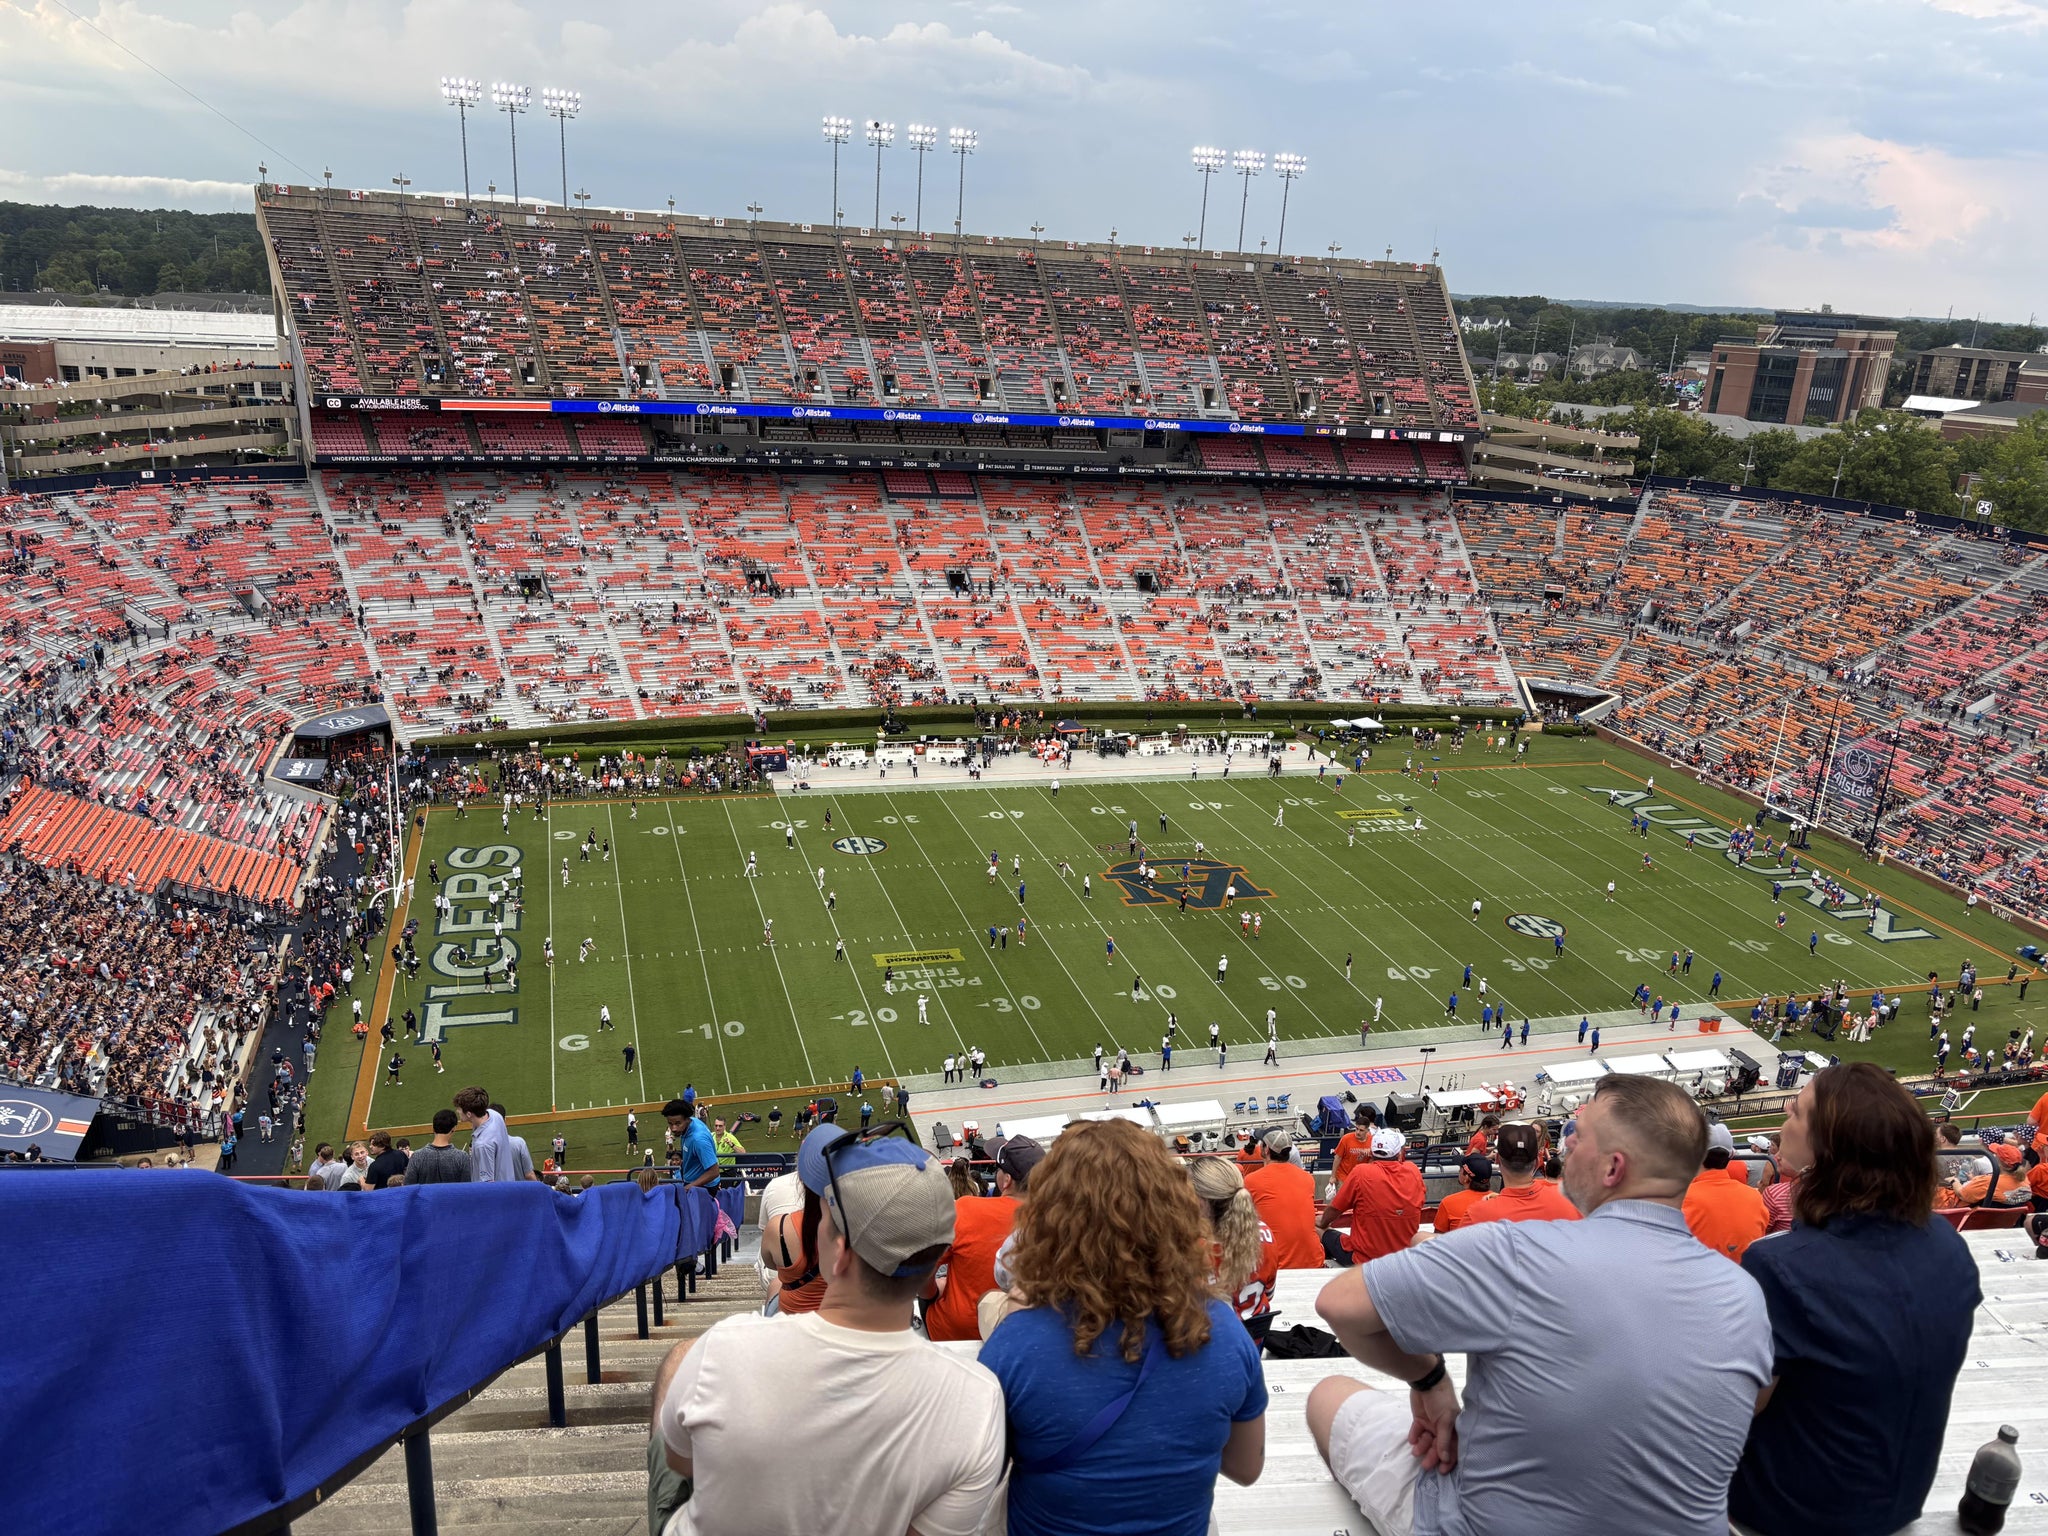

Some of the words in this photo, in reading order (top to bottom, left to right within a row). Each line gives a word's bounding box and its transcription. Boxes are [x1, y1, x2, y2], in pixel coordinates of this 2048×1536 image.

[611, 404, 640, 412] Allstate
[710, 406, 737, 414] Allstate
[896, 412, 921, 420] Allstate
[984, 415, 1009, 423] Allstate
[1240, 425, 1265, 433] Allstate
[1979, 503, 1990, 513] 25
[1833, 772, 1873, 797] Allstate
[1546, 786, 1569, 795] G
[1284, 797, 1318, 806] 30
[1376, 793, 1411, 802] 20
[1091, 806, 1126, 815] 50
[1189, 802, 1224, 811] 40
[989, 810, 1024, 819] 40
[771, 819, 809, 829] 20
[883, 815, 920, 825] 30
[652, 825, 687, 835] 10
[554, 831, 576, 840] G
[834, 837, 887, 855] SEC
[1581, 785, 1942, 943] AUBURN
[1506, 915, 1566, 938] SEC
[414, 843, 525, 1046] TIGERS
[1823, 933, 1853, 946] G
[1728, 939, 1769, 953] 10
[886, 954, 954, 963] YellaWood
[1615, 947, 1660, 963] 20
[1502, 957, 1550, 972] 30
[891, 967, 960, 980] FIELD
[1387, 965, 1431, 981] 40
[938, 977, 983, 988] PAT
[1258, 975, 1307, 991] 50
[992, 995, 1041, 1013] 30
[847, 1007, 898, 1027] 20
[699, 1020, 745, 1040] 10
[559, 1034, 590, 1052] G
[1507, 1100, 1515, 1108] G
[1272, 1385, 1285, 1393] 18
